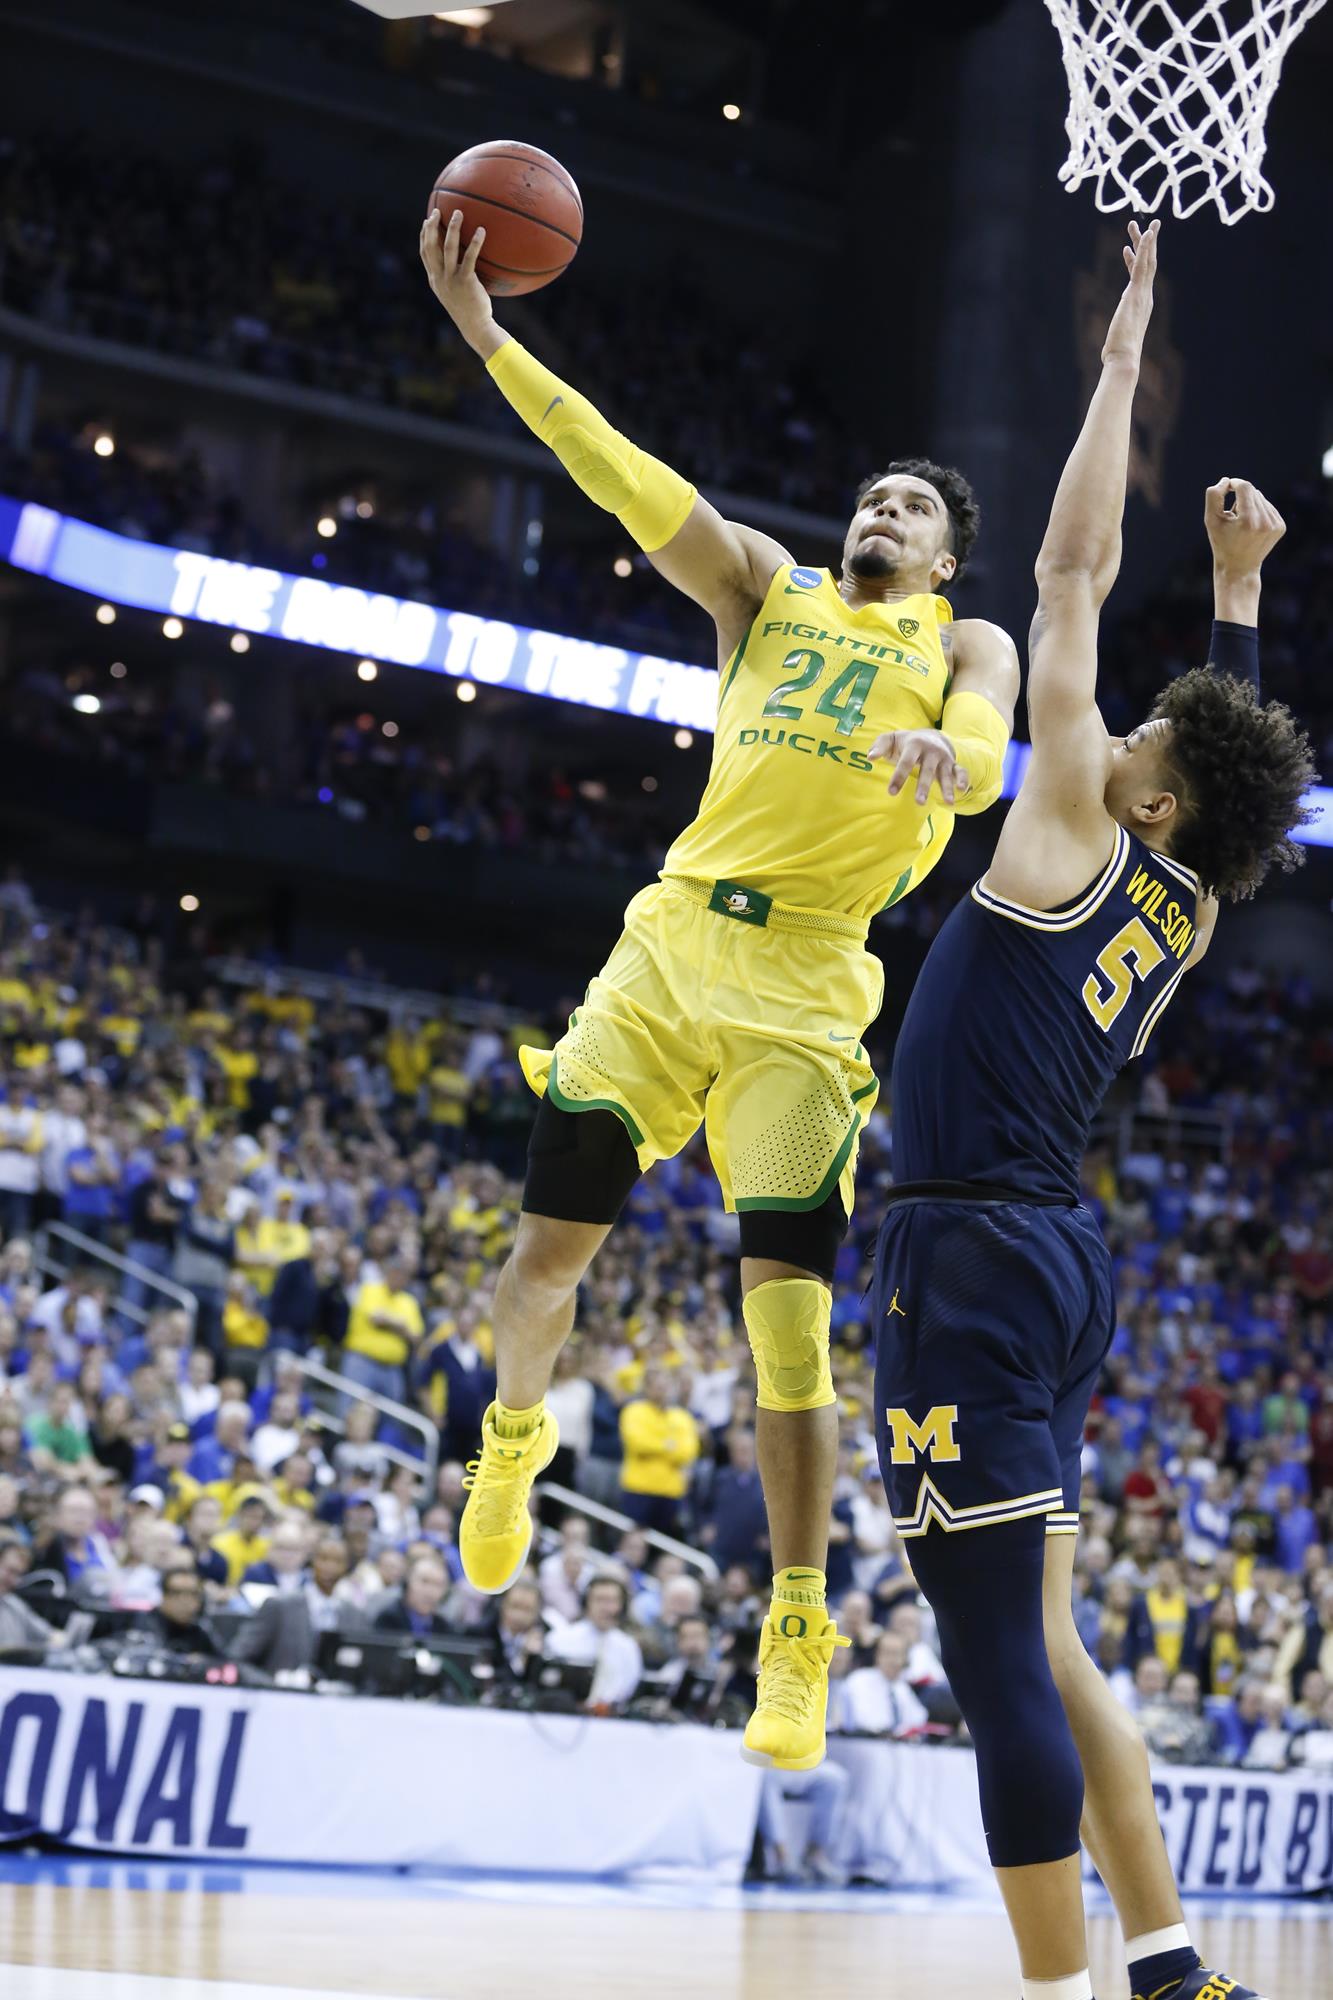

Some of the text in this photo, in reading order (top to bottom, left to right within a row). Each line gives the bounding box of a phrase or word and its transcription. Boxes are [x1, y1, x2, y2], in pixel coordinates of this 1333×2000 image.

[170, 551, 283, 634] THE
[445, 612, 518, 683] TO
[762, 621, 931, 678] FIGHTING
[762, 648, 879, 737] 24
[739, 728, 873, 772] DUCKS
[1126, 863, 1196, 959] WILSON
[1082, 916, 1166, 1032] 5
[886, 1405, 960, 1464] M
[0, 1692, 248, 1848] ONAL
